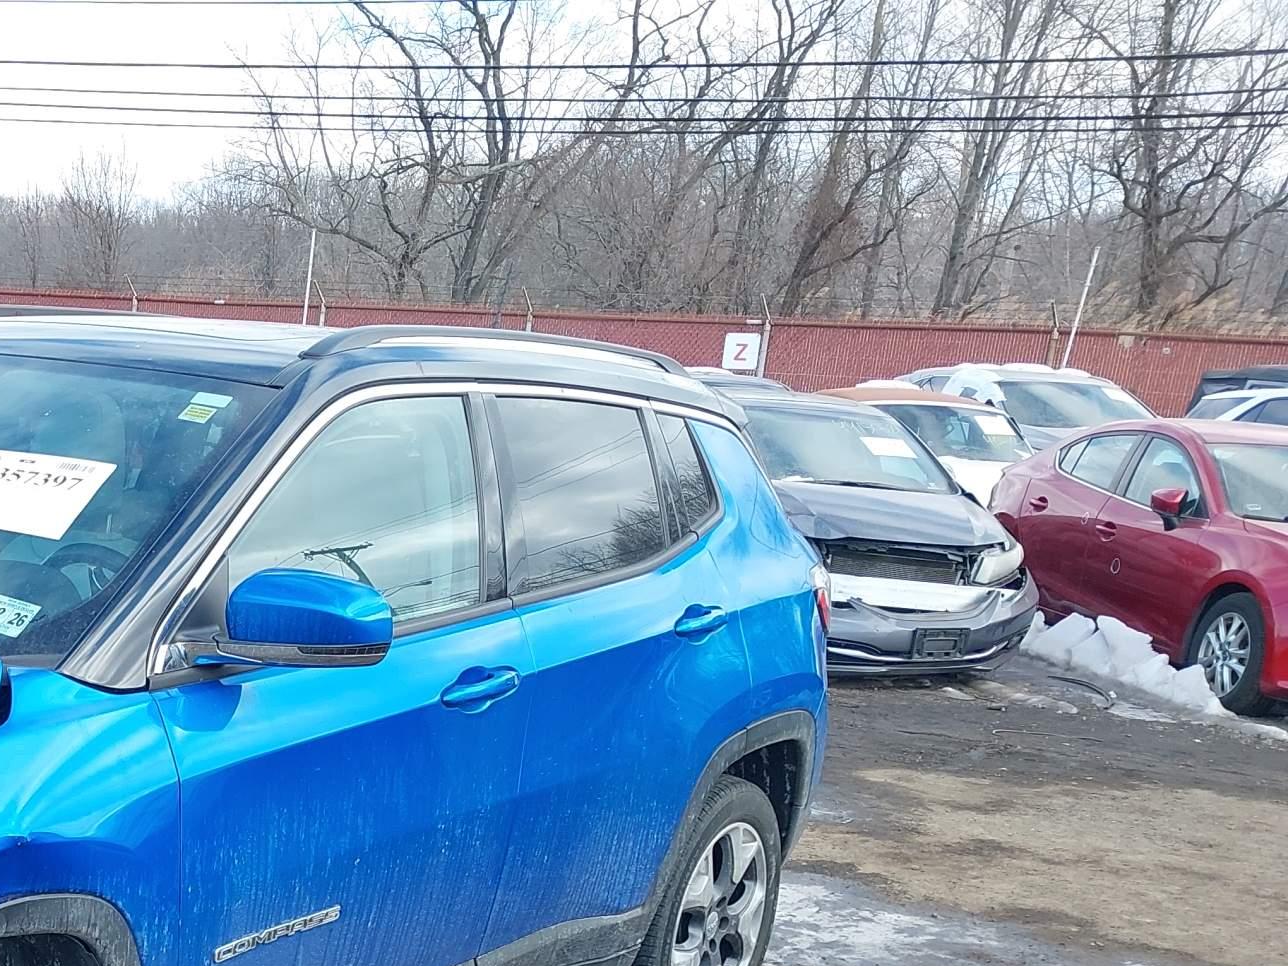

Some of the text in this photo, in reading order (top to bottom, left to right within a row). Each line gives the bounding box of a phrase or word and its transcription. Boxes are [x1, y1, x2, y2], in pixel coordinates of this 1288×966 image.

[733, 342, 749, 361] Z
[7, 612, 28, 627] 26
[214, 904, 342, 964] COMPASS
